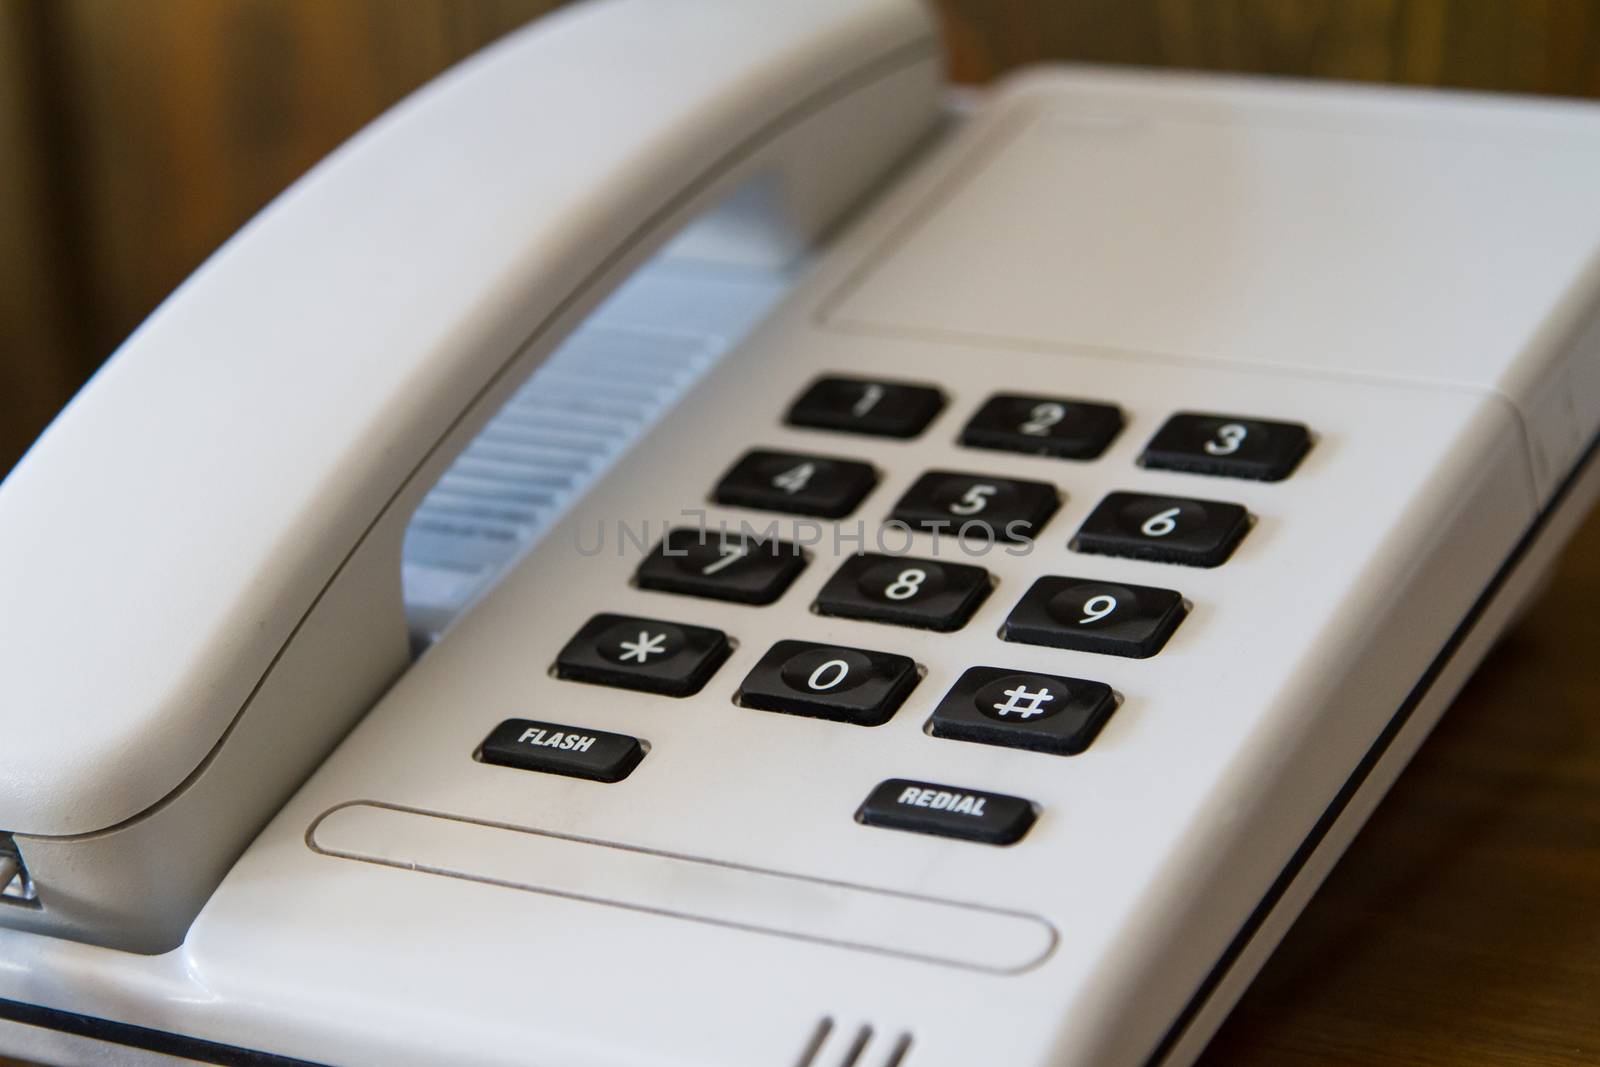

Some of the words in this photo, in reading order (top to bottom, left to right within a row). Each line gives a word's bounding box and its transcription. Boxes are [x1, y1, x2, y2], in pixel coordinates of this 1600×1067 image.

[853, 384, 883, 417] 1
[1023, 402, 1064, 435] 2
[1205, 424, 1247, 455] 3
[773, 462, 816, 493] 4
[951, 485, 996, 514] 5
[1141, 507, 1181, 537] 6
[702, 542, 749, 575] 7
[885, 568, 927, 601] 8
[1078, 594, 1118, 625] 9
[807, 659, 849, 691] 0
[993, 685, 1055, 720] #
[517, 727, 597, 754] FLASH
[897, 786, 987, 818] REDIAL
